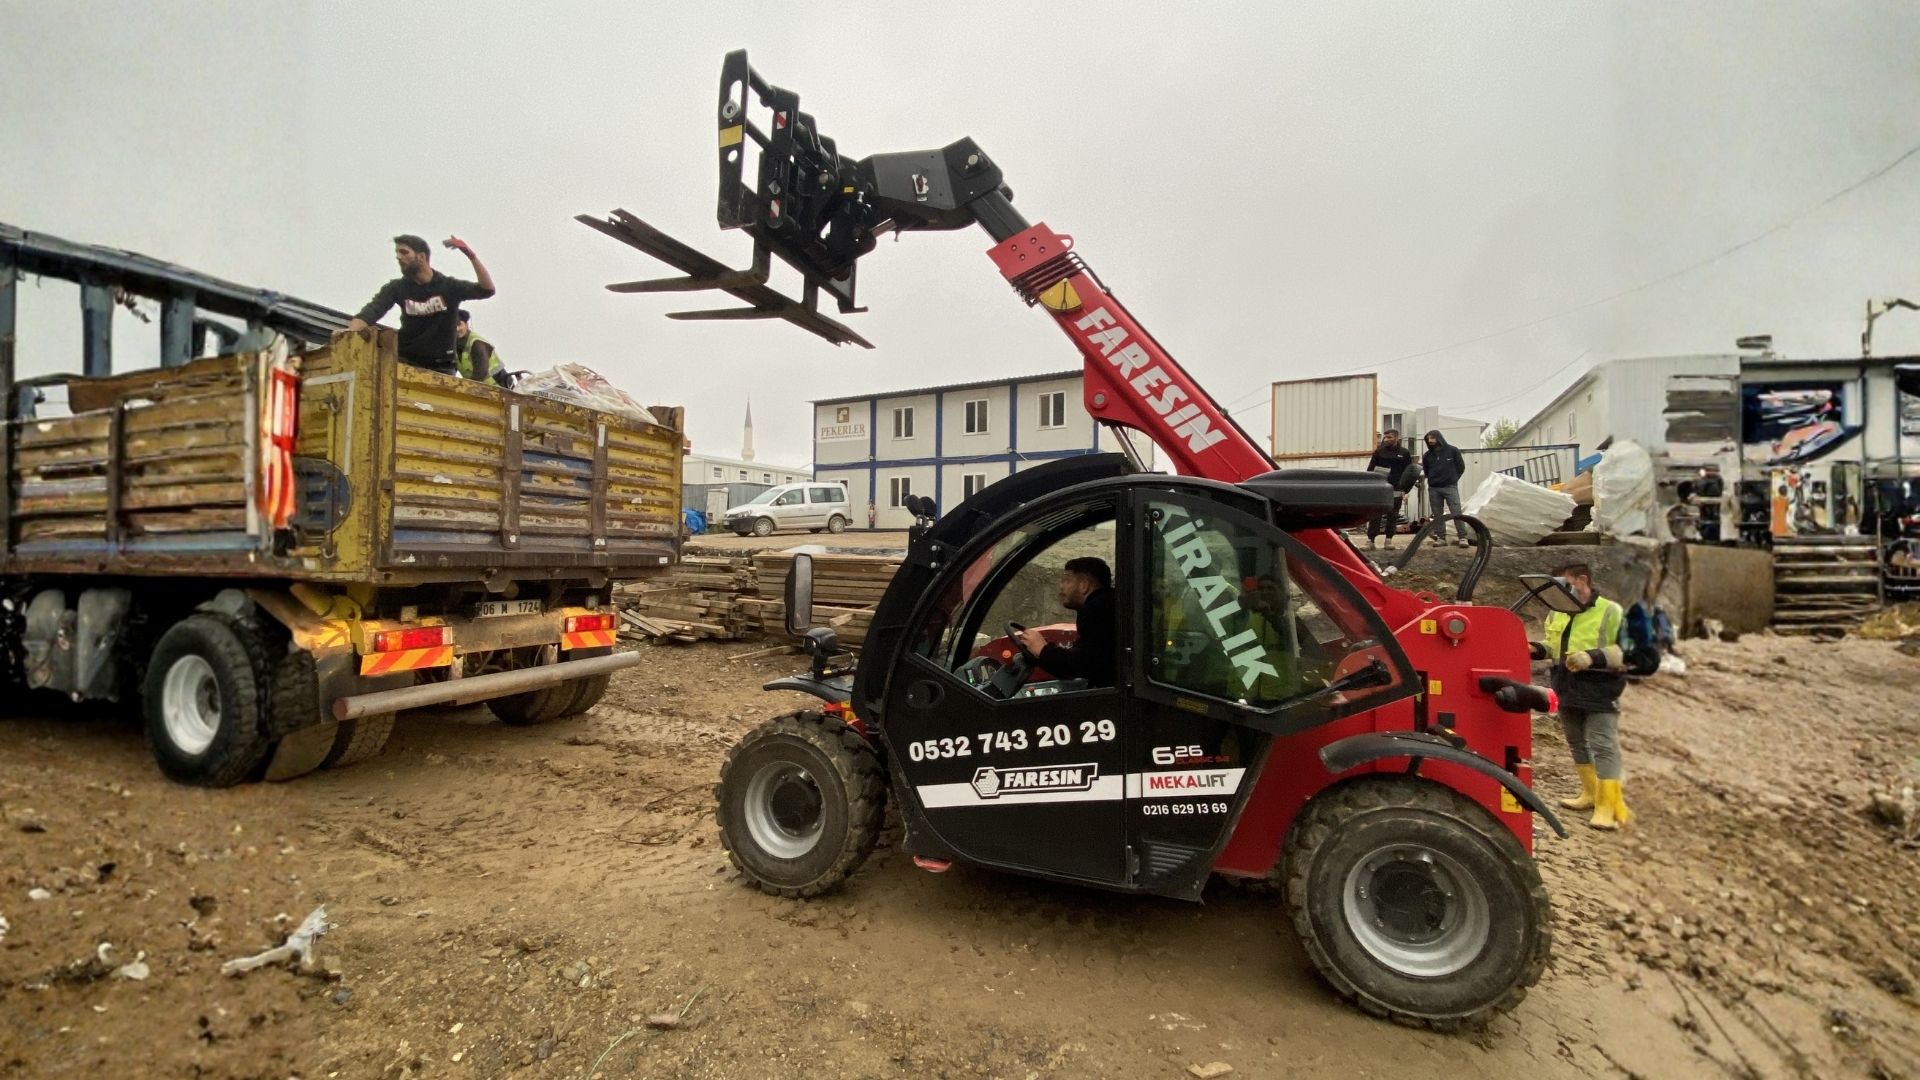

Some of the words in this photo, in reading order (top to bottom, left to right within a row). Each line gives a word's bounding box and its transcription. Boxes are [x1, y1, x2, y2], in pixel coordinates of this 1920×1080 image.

[1074, 306, 1229, 454] FARESIN
[821, 424, 865, 437] PEKERLER
[483, 604, 495, 616] 06
[518, 601, 540, 613] 1724
[909, 736, 972, 762] 0532
[978, 729, 1029, 754] 743
[1036, 724, 1071, 748] 20
[1079, 719, 1116, 743] 29
[1152, 745, 1204, 765] 626
[1004, 769, 1083, 788] FARESIN
[1149, 774, 1227, 790] MEKALIFT
[1143, 804, 1170, 815] 0216
[1172, 803, 1195, 814] 629
[1197, 803, 1209, 814] 13
[1211, 802, 1228, 813] 69
